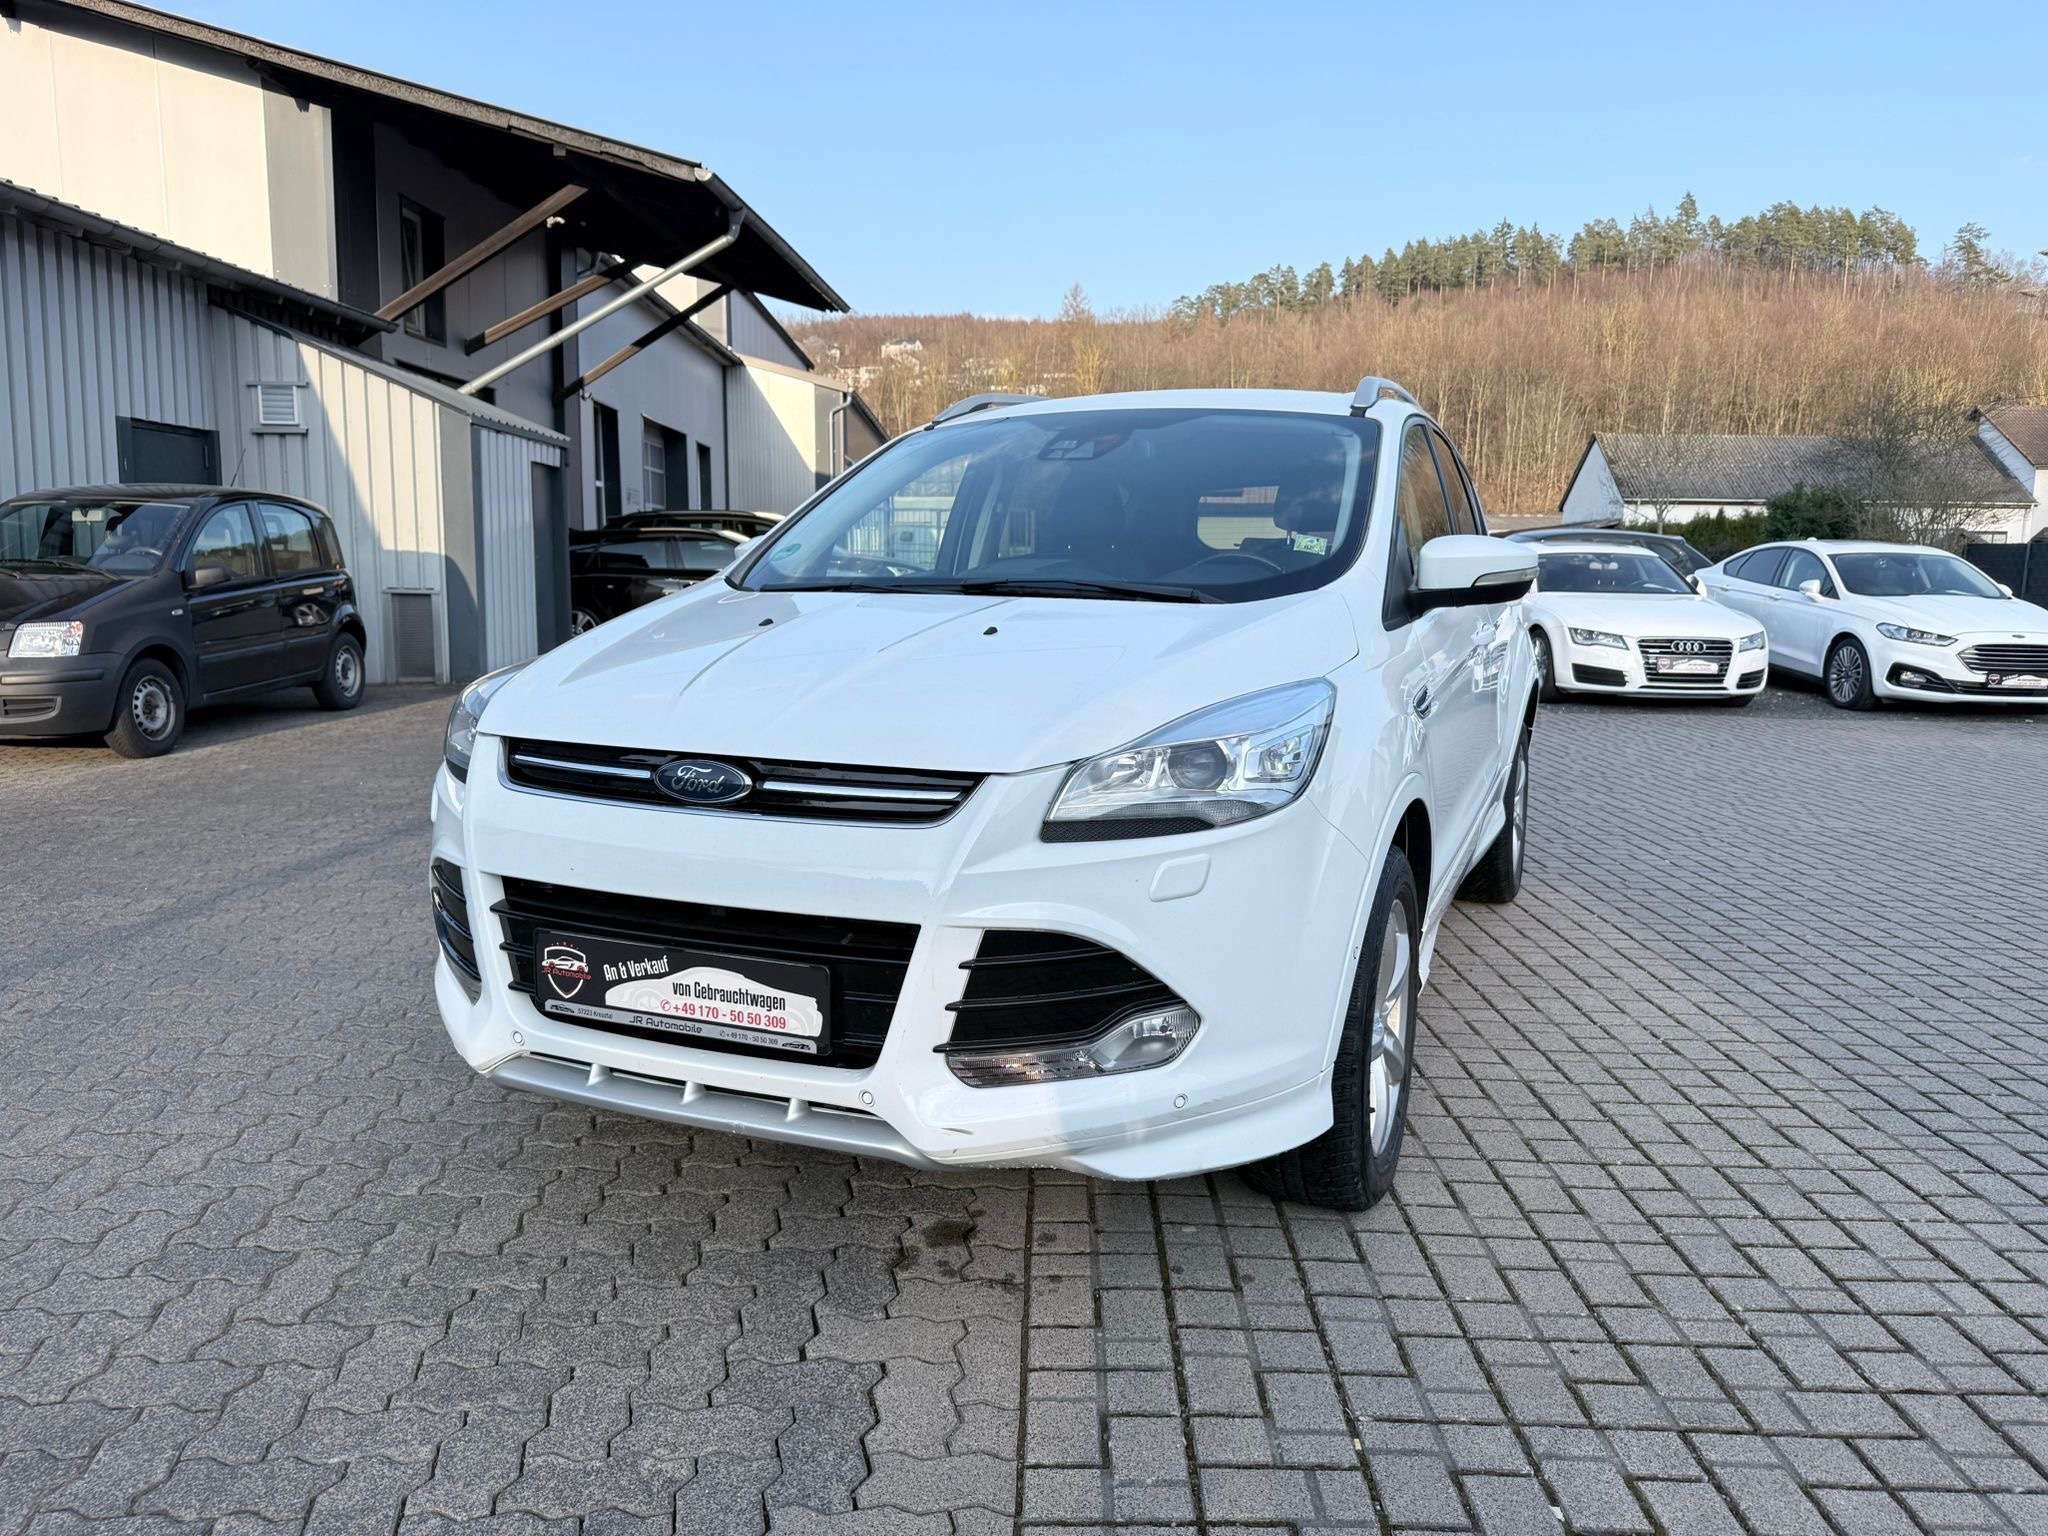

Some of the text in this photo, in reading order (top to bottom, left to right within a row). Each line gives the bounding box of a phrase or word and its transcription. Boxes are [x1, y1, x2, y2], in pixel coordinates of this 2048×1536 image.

[671, 765, 725, 793] Ford
[603, 955, 669, 981] An & Verkauf
[672, 981, 786, 1012] von Gebrauchtwagen
[628, 1015, 703, 1034] JR Automobile
[673, 1001, 696, 1014] +49
[699, 1005, 719, 1019] 170
[730, 1010, 744, 1023] 50
[747, 1012, 761, 1026] 50
[764, 1015, 786, 1029] 309
